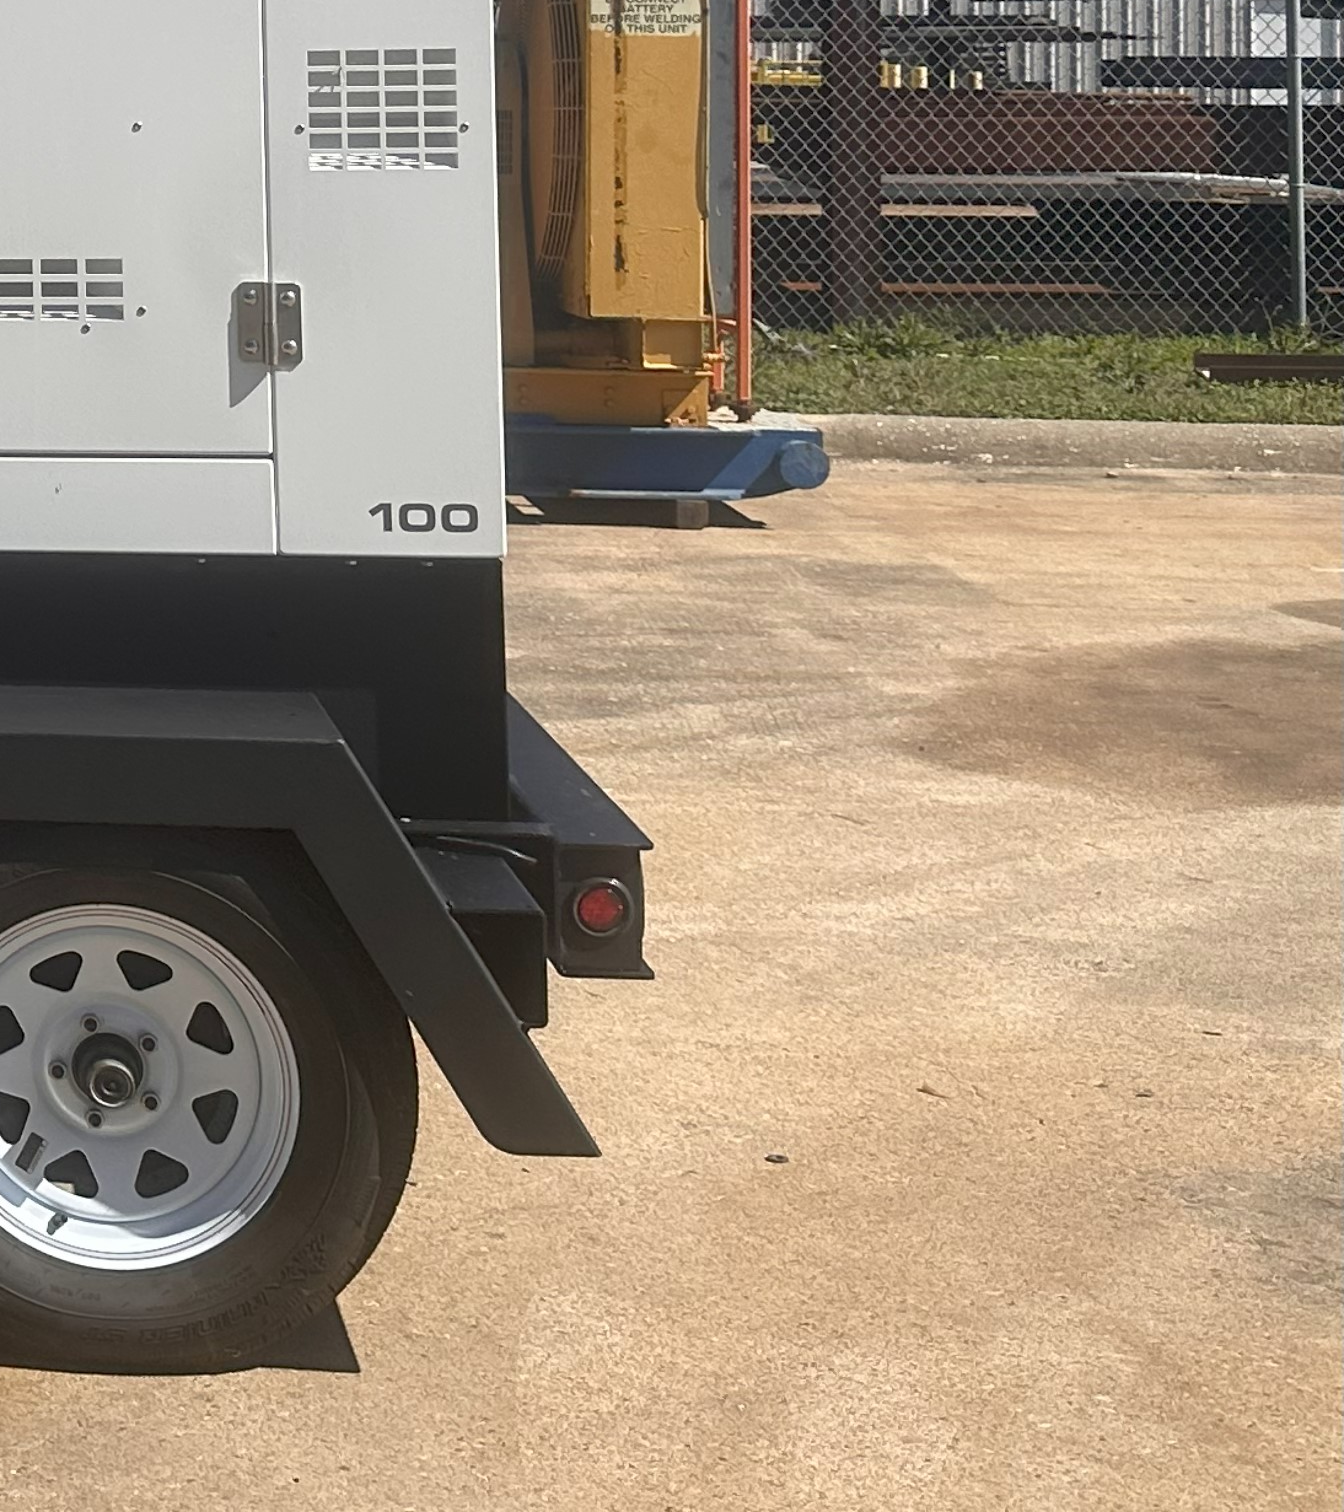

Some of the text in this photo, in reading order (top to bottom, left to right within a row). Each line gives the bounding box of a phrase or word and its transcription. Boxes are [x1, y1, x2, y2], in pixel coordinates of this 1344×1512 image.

[621, 4, 674, 13] ATTERY
[644, 14, 702, 23] WELDING
[627, 24, 656, 33] THIS
[658, 24, 688, 33] UNIT
[368, 503, 479, 533] 100
